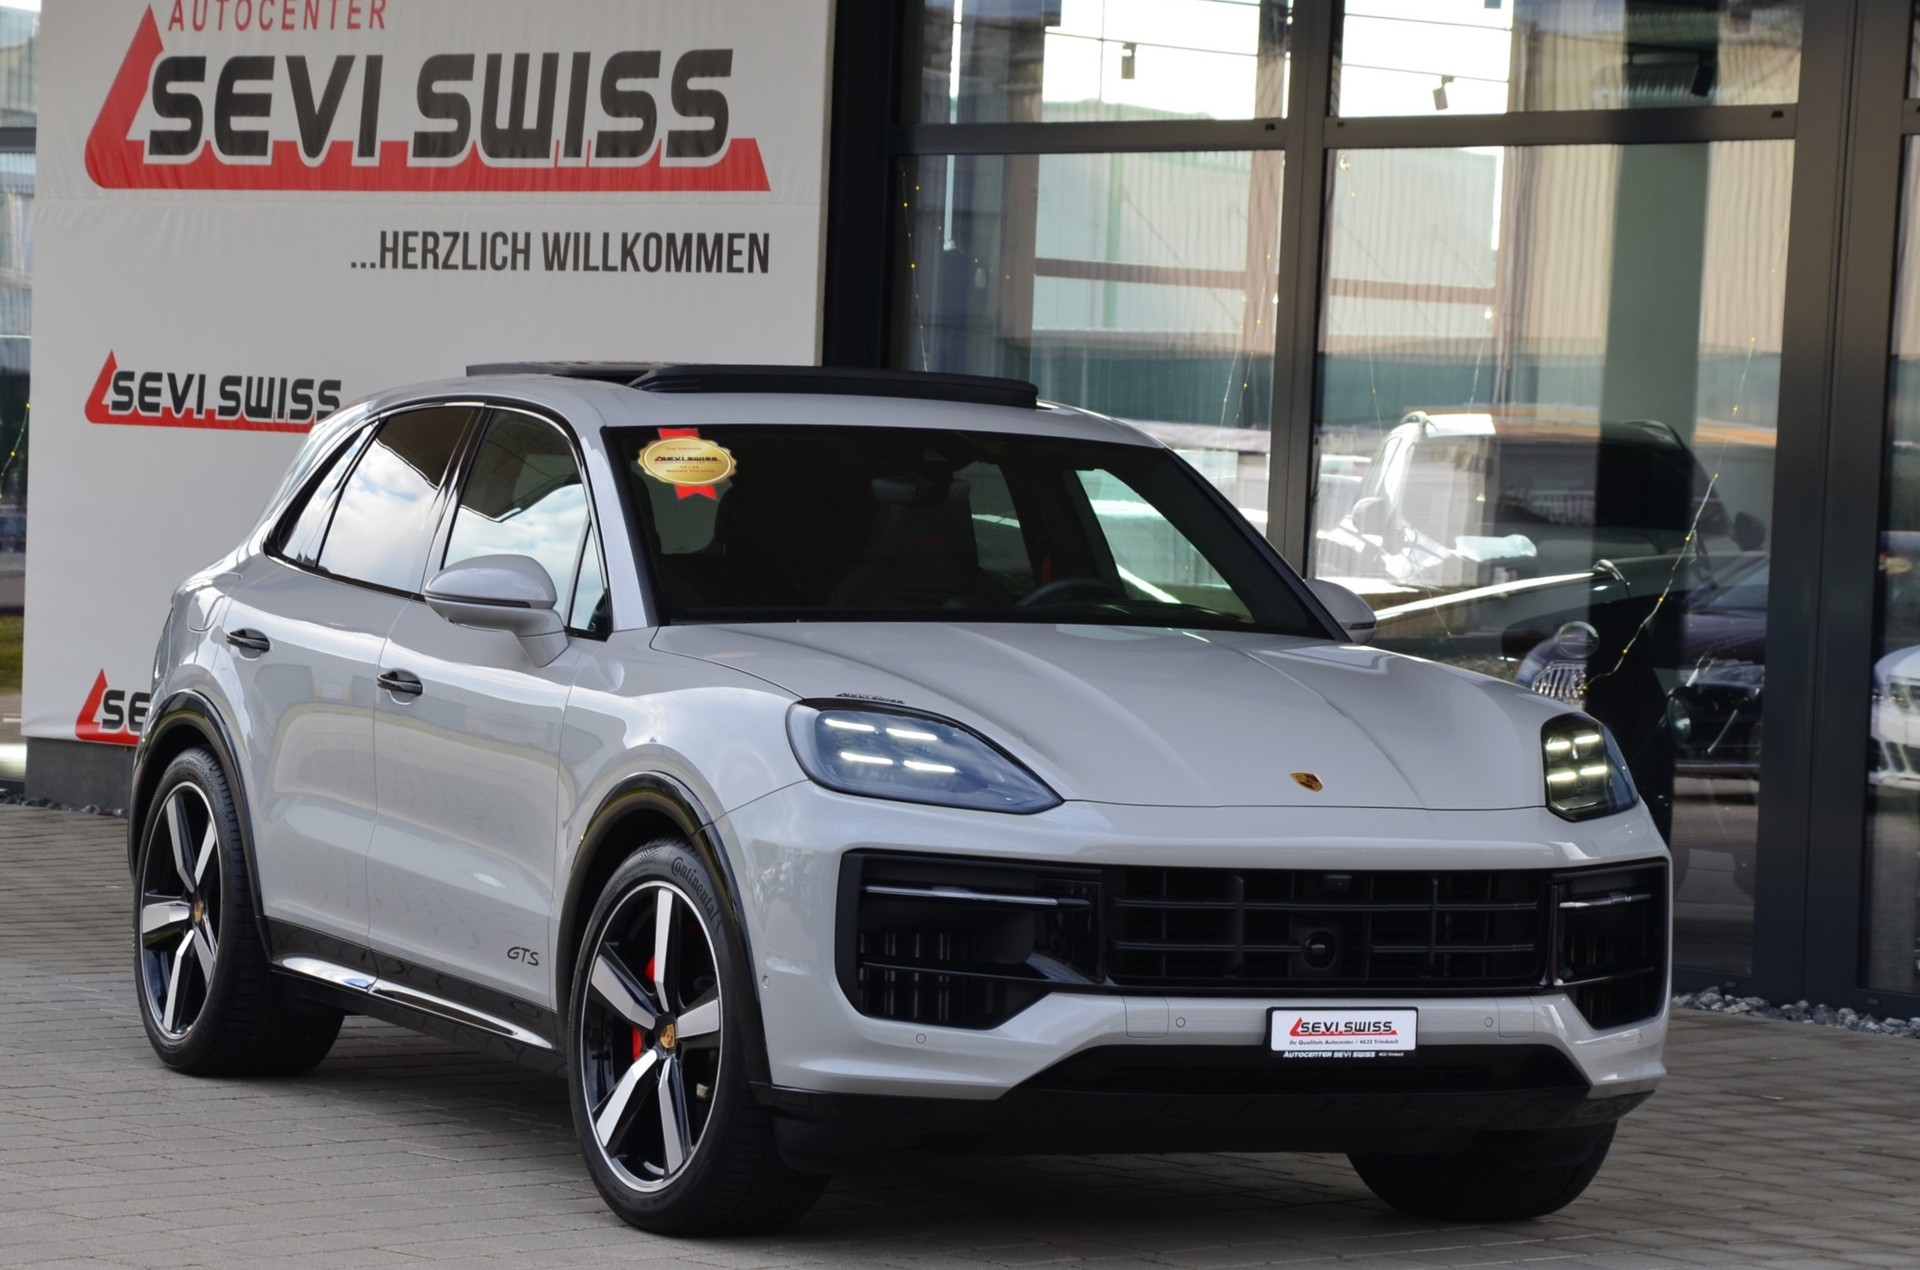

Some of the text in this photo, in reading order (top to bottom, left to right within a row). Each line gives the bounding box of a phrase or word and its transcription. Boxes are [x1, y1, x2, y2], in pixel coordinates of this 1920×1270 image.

[168, 0, 386, 31] AUTOCENTER
[148, 48, 734, 159] SEVI SWISS
[350, 230, 770, 274] ...HERZLICH WILLKOMMEN
[111, 370, 342, 422] SEVI SWISS
[671, 856, 720, 922] Continental
[507, 946, 539, 966] GTS
[1300, 1021, 1393, 1033] SEVI SWISS
